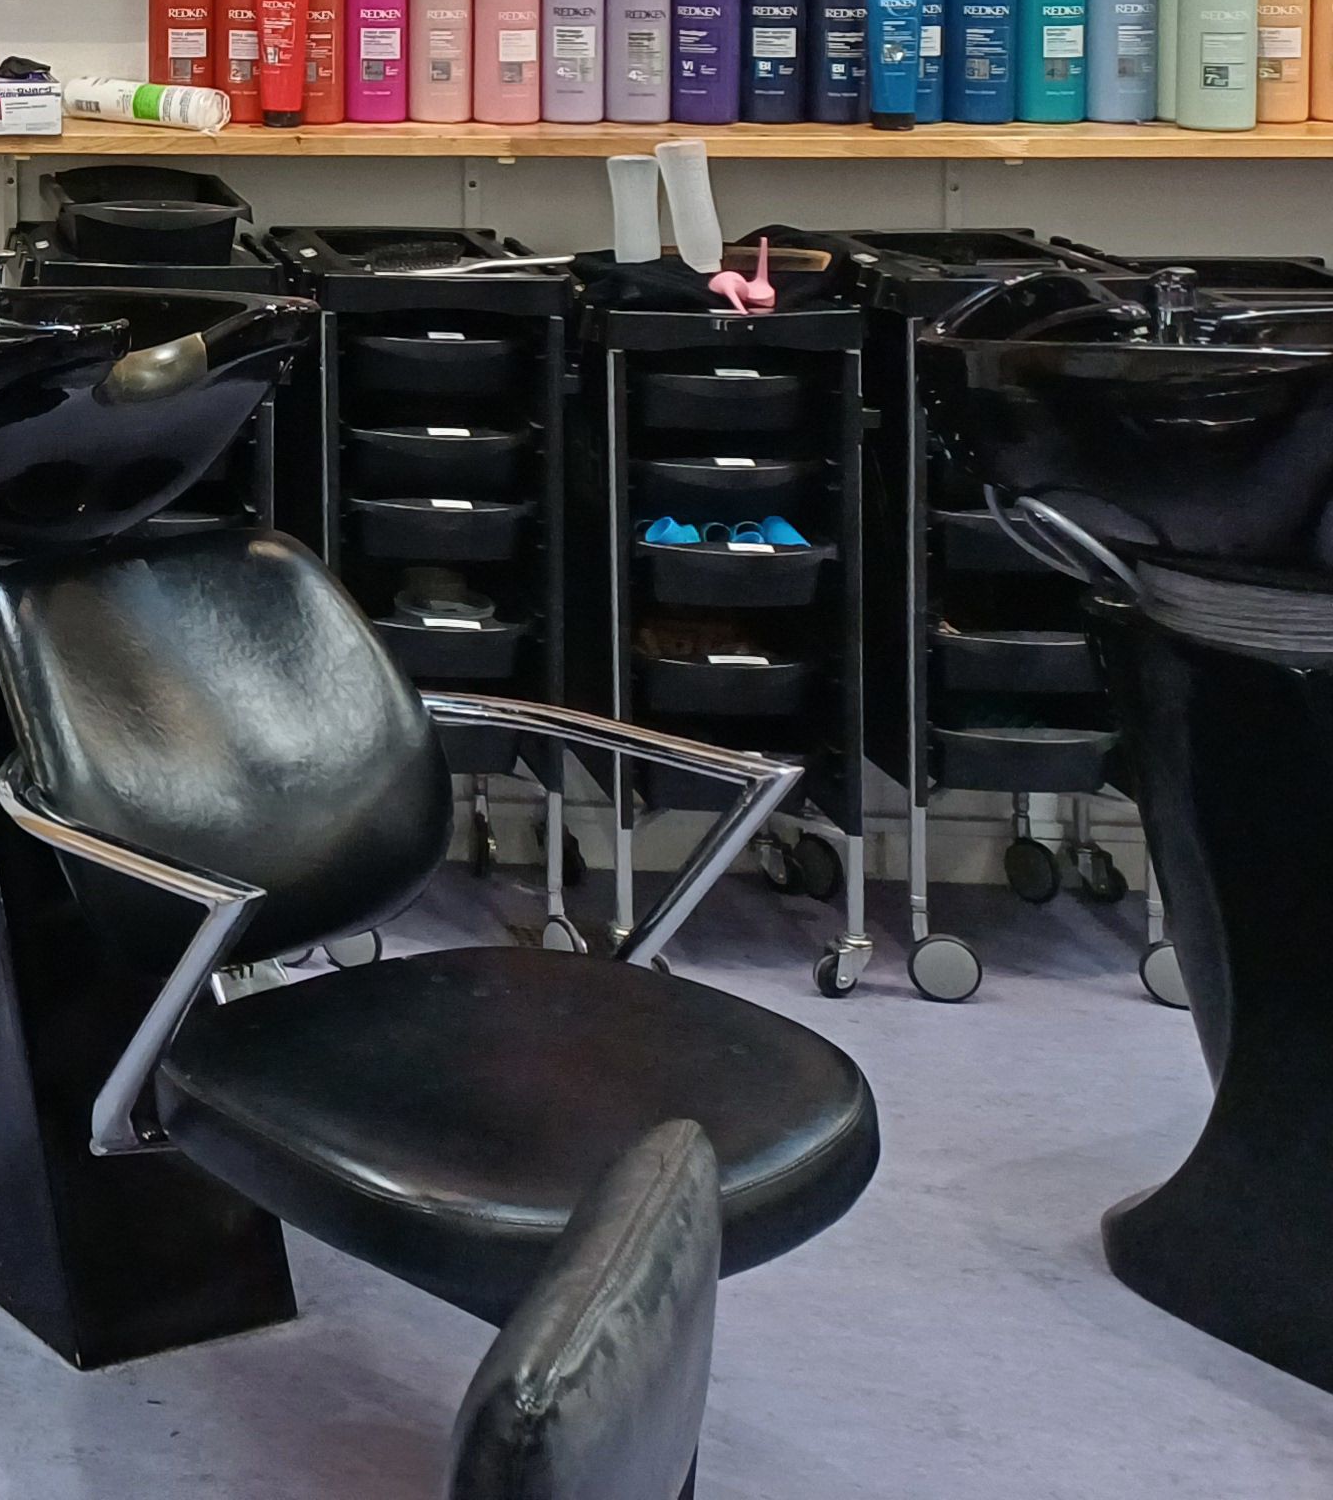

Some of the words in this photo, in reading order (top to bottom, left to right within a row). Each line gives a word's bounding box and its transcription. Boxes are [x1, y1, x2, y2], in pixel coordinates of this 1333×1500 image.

[262, 0, 296, 9] REDKEN
[880, 0, 917, 7] REDKEN
[168, 8, 208, 18] REDKEN
[360, 9, 402, 19] REDKEN
[427, 9, 468, 19] REDKEN
[553, 7, 596, 16] REDKEN
[677, 6, 722, 16] REDKEN
[752, 6, 798, 16] REDKEN
[825, 8, 868, 18] REDKEN
[963, 5, 1010, 15] REDKEN
[1042, 5, 1085, 16] REDKEN
[1115, 4, 1155, 14] REDKEN
[1258, 5, 1303, 15] REDKEN
[498, 11, 537, 21] REDKEN
[625, 10, 667, 19] REDKEN
[1201, 10, 1251, 20] REDKEN
